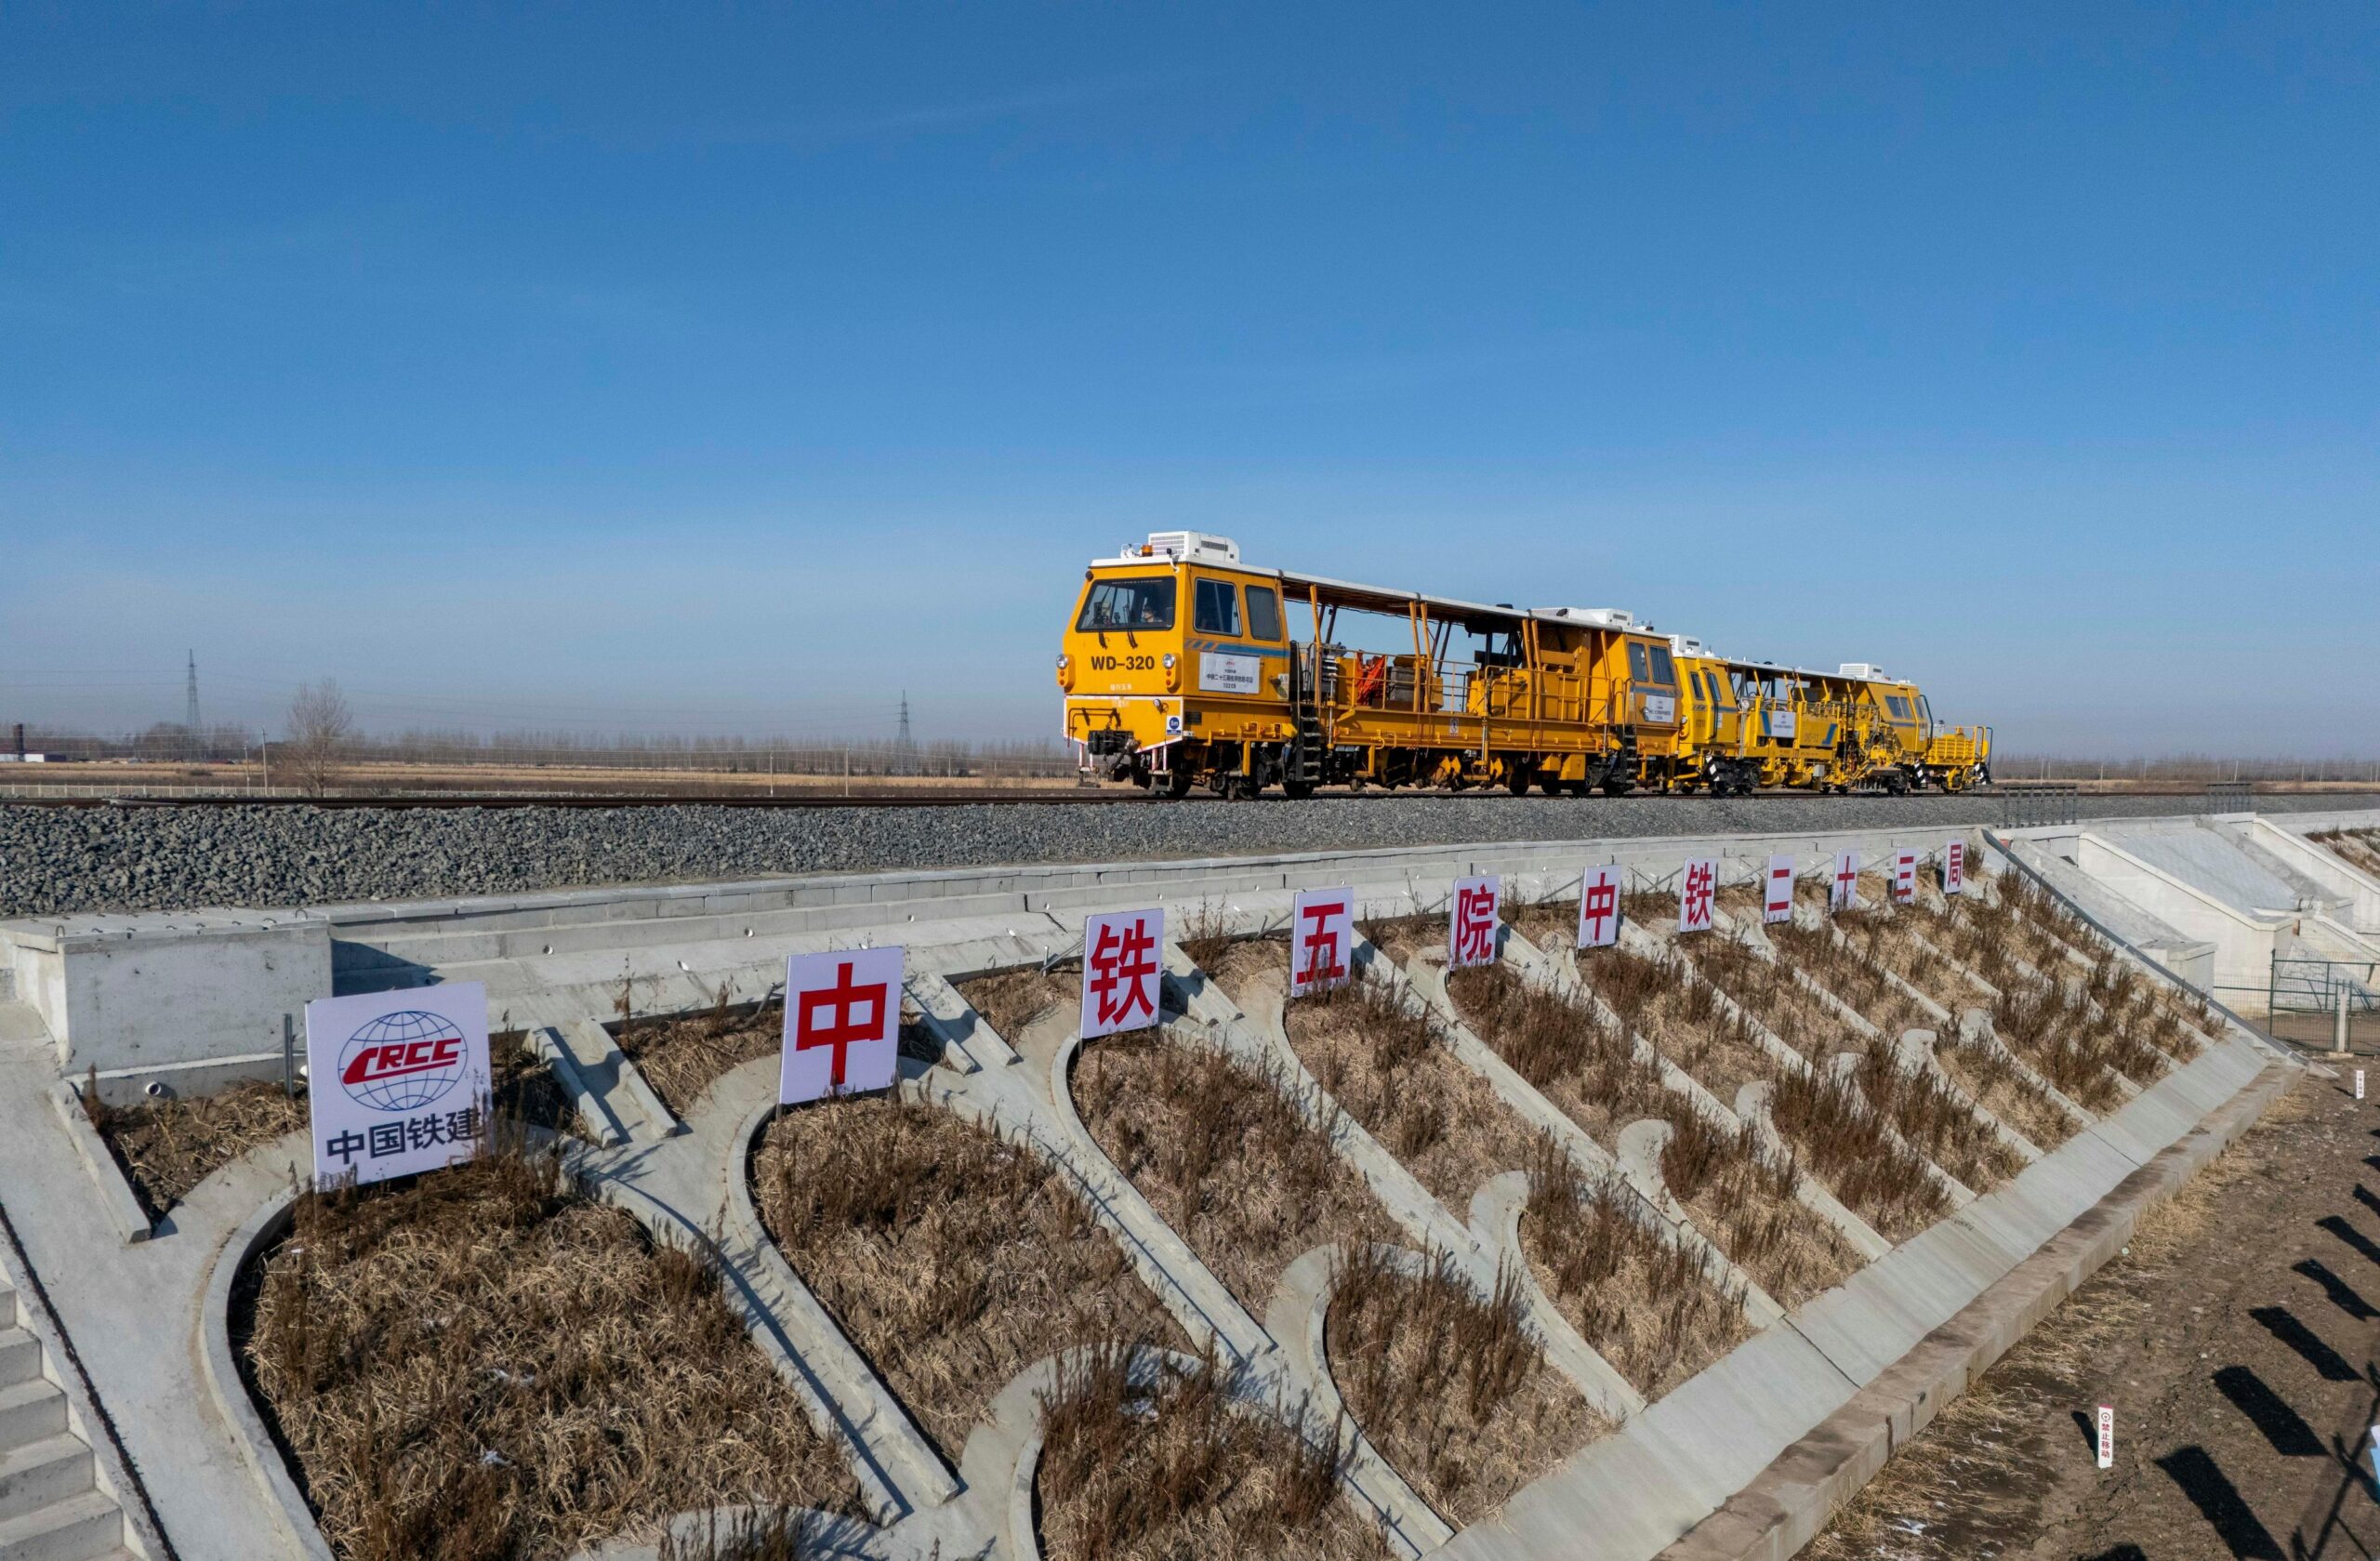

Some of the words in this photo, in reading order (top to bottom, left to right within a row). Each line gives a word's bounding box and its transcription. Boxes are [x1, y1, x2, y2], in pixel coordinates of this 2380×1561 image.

[1091, 655, 1155, 670] WD-320
[796, 962, 887, 1086] 中
[1090, 919, 1157, 1025] 铁
[1296, 902, 1345, 985] 五
[1455, 883, 1495, 963] 院
[1585, 872, 1616, 941] 中
[1685, 862, 1712, 926] 铁
[1768, 868, 1790, 912] 二
[1837, 855, 1856, 906] 十
[1895, 855, 1915, 897] 三
[1948, 843, 1962, 887] 局
[342, 1038, 462, 1086] CRCC
[326, 1106, 482, 1165] 中国铁建
[2101, 1422, 2110, 1459] 禁止移动
